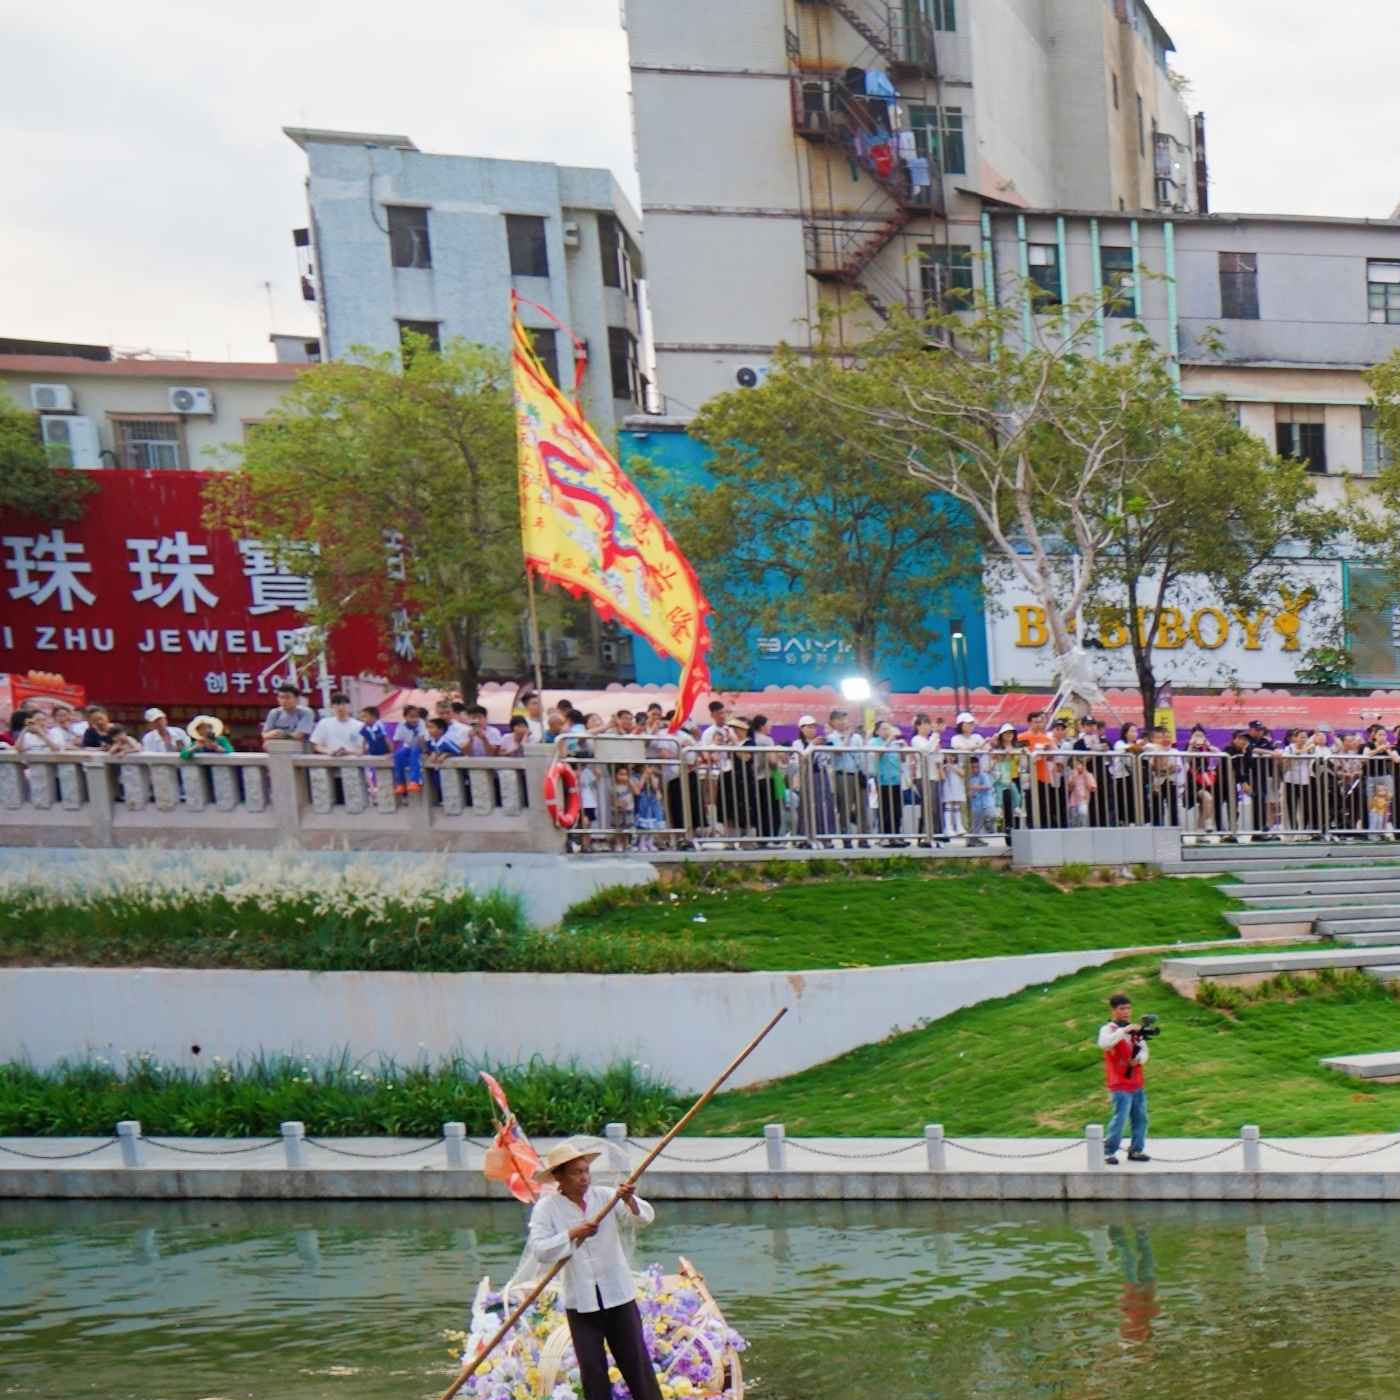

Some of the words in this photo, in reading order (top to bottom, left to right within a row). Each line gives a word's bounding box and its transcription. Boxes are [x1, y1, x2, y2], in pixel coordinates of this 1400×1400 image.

[36, 626, 115, 651] ZHU
[138, 629, 326, 656] JEWELR
[1013, 605, 1268, 651] BBIBOY
[205, 672, 338, 694] 创于191年
